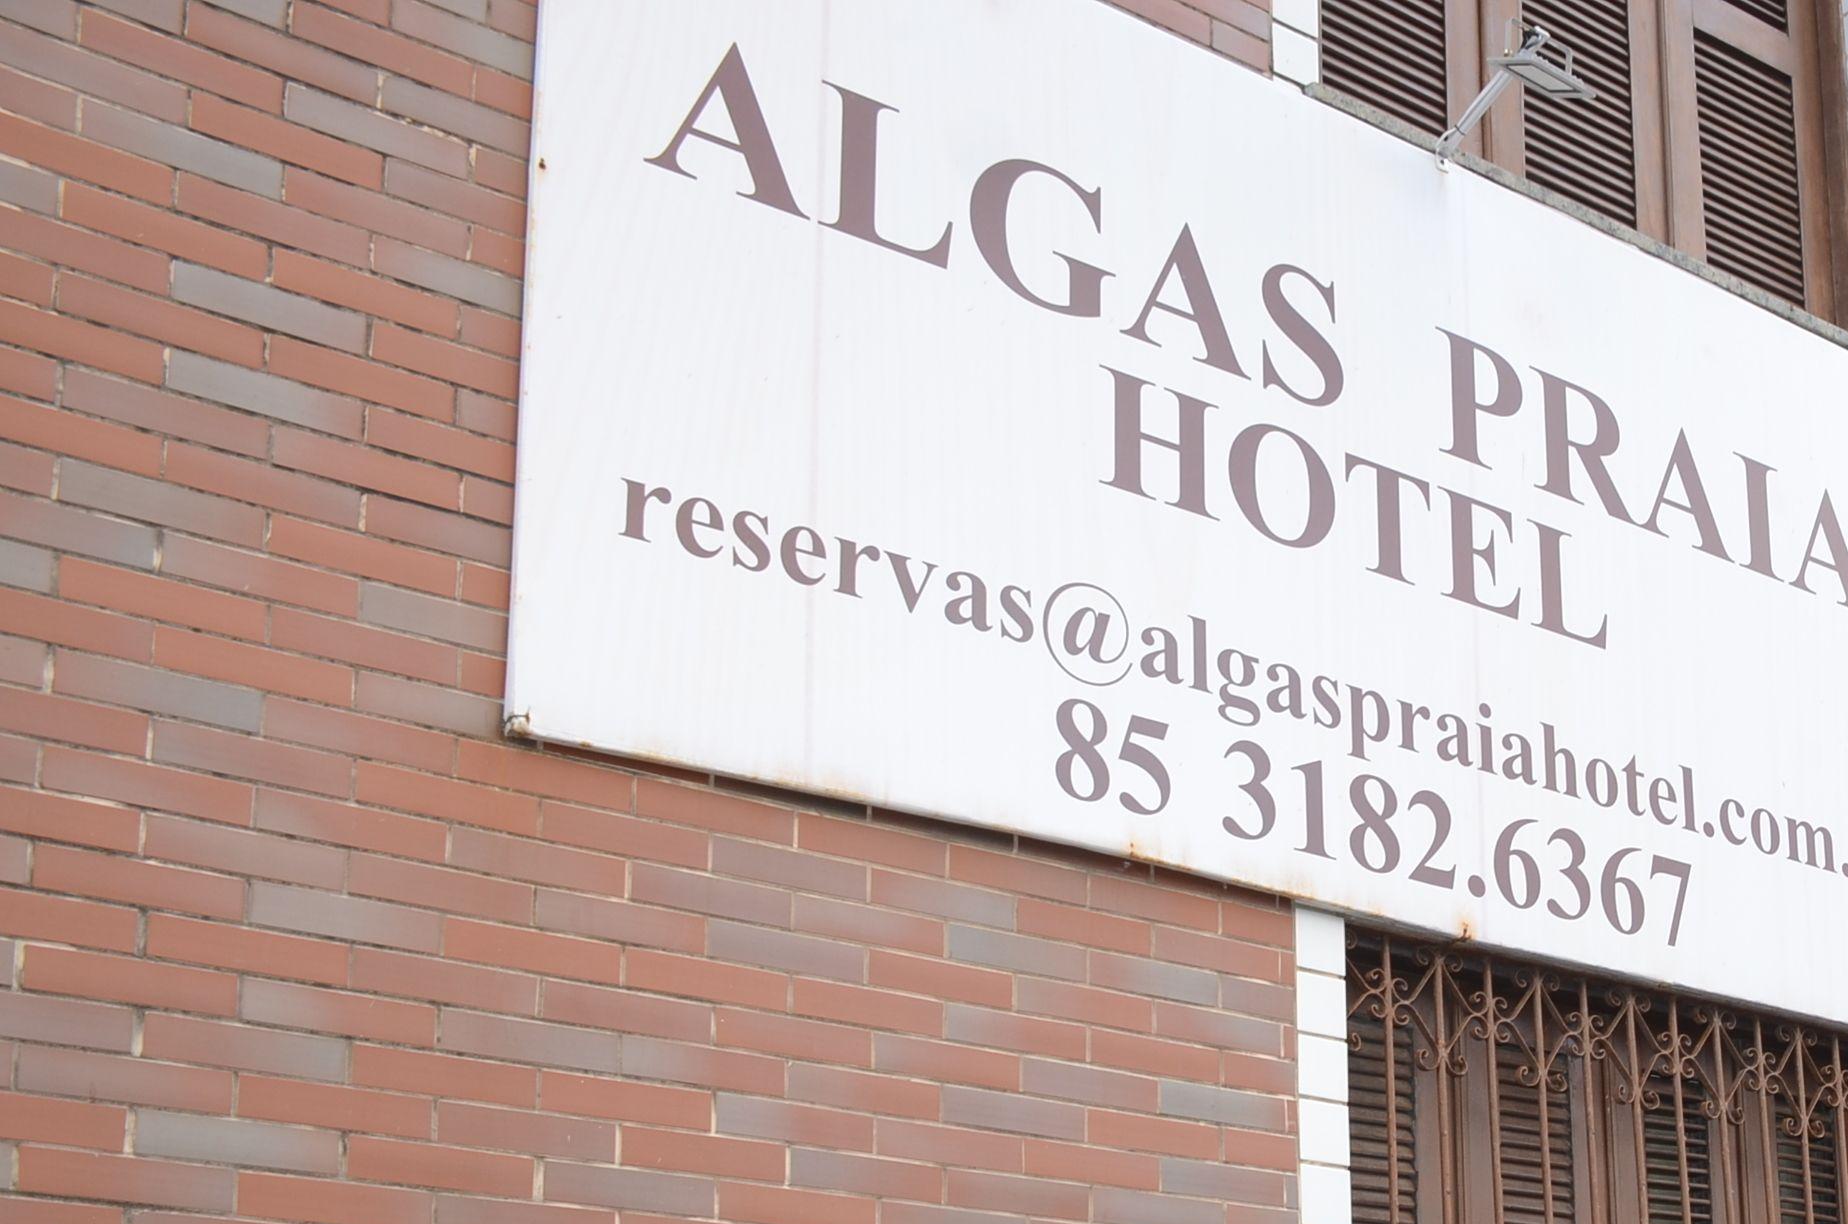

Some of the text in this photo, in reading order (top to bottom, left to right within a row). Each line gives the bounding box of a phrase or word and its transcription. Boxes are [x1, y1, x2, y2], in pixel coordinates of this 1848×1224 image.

[643, 41, 1344, 407] ALGAS
[1098, 364, 1608, 650] HOTEL
[1055, 698, 1692, 947] 85 3182.6367
